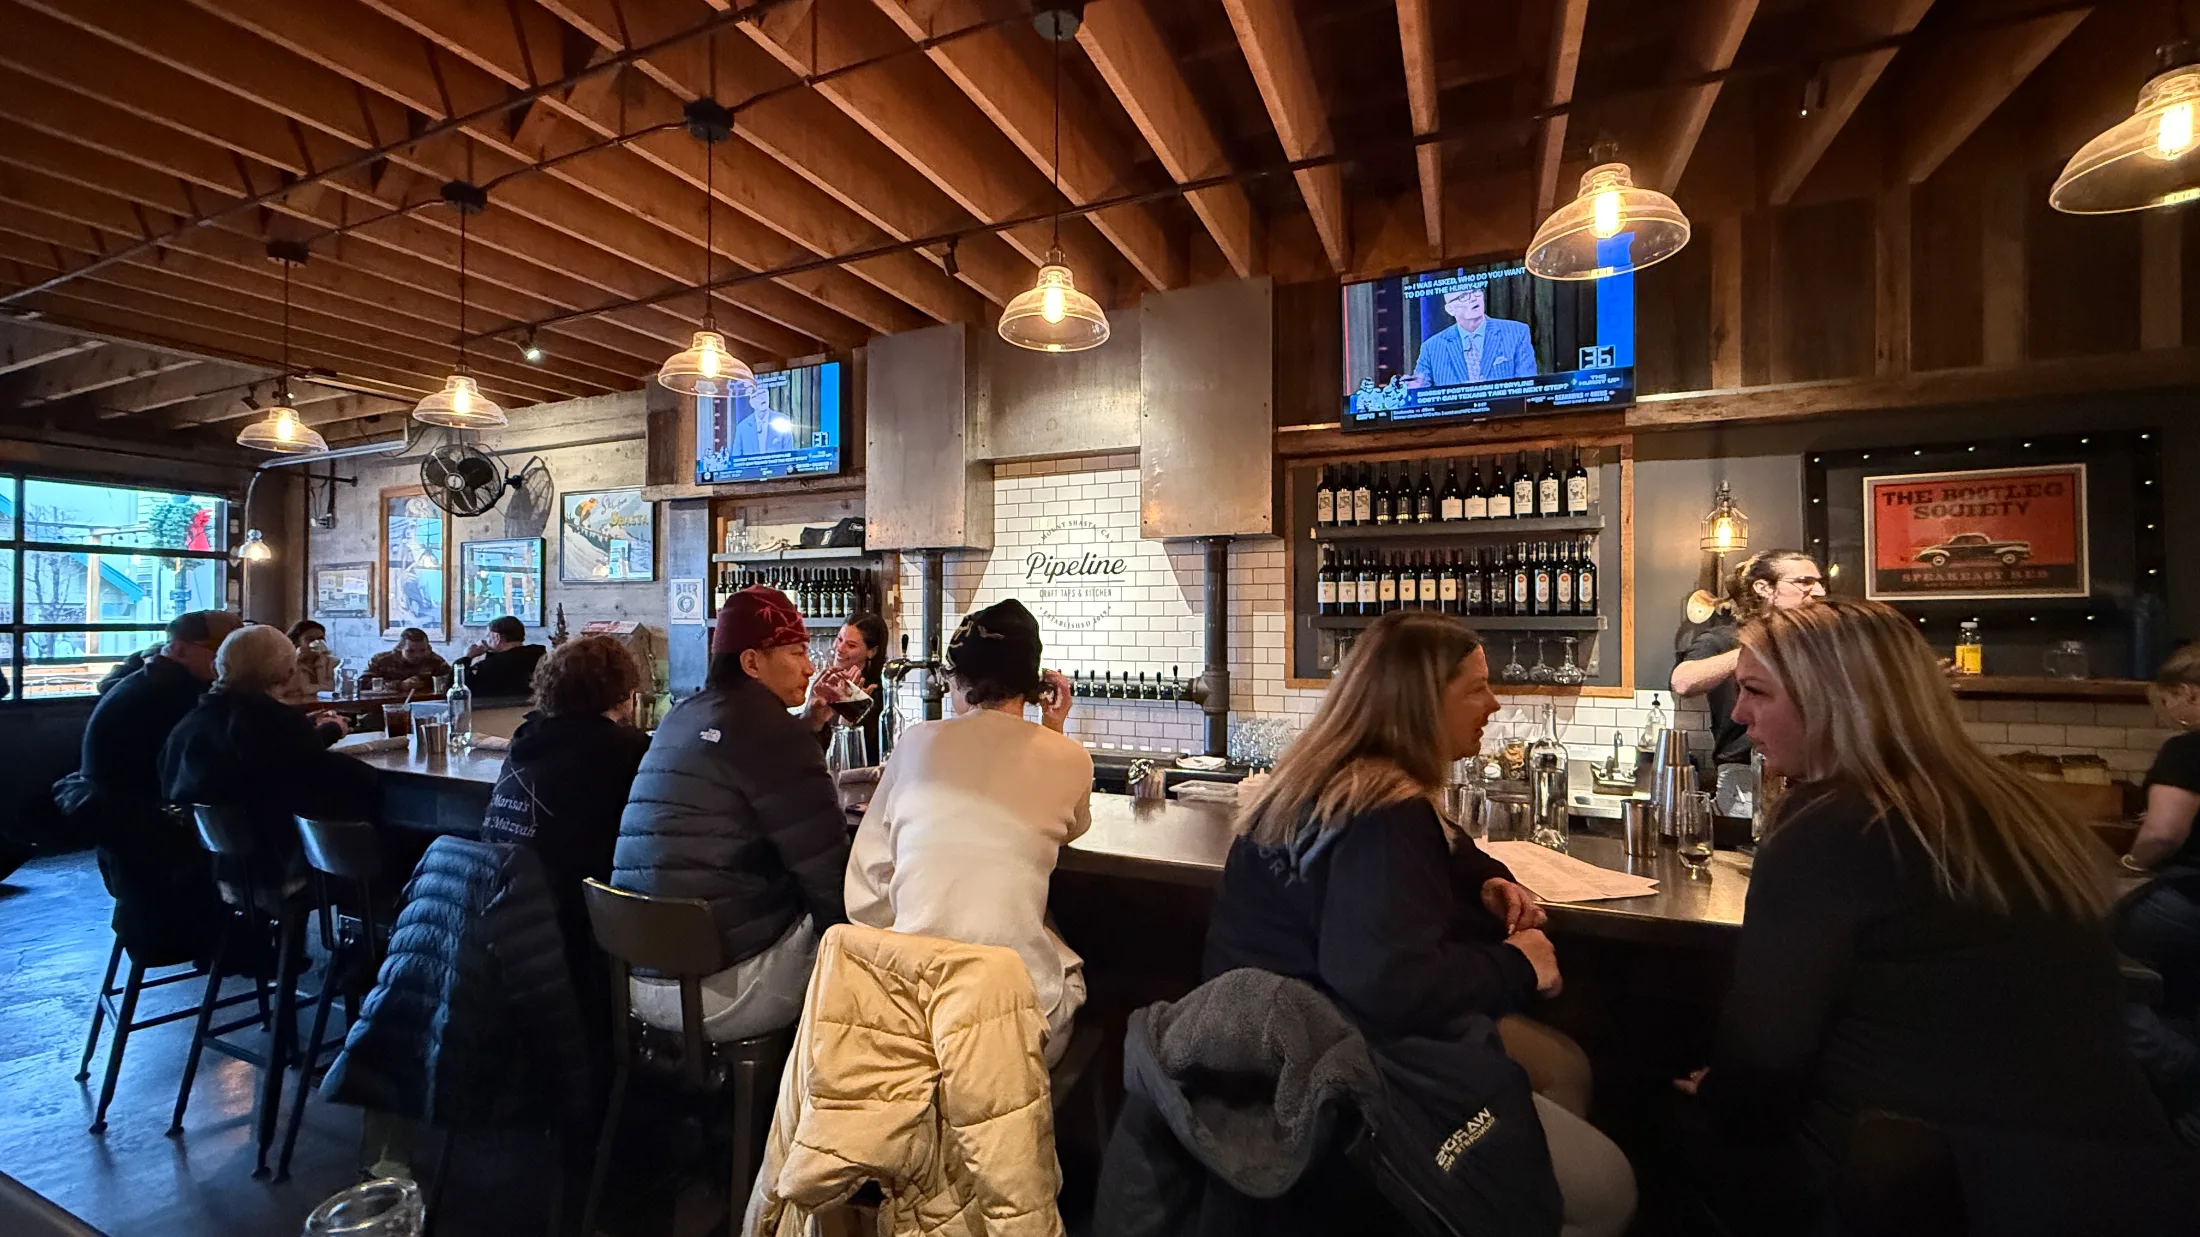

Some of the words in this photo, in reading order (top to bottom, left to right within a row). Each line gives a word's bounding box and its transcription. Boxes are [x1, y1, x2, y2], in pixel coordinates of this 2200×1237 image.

[1416, 280, 1433, 289] WAS
[1433, 277, 1457, 287] ASKED,
[1457, 274, 1475, 284] WHO
[1477, 272, 1487, 281] DO
[1488, 270, 1503, 279] YOU
[1504, 266, 1526, 277] WANT
[1404, 291, 1414, 299] TO
[1415, 289, 1425, 297] DO
[1426, 288, 1433, 296] IN
[1434, 286, 1448, 295] THE
[1449, 281, 1488, 292] HURRY-UP?
[1584, 346, 1611, 369] 36
[1446, 384, 1493, 394] POSTSEASON
[1494, 380, 1534, 389] STORYLINE
[1458, 391, 1487, 399] TEXANS
[1488, 389, 1507, 397] TAKE
[1523, 385, 1543, 393] NEXT
[1544, 383, 1569, 391] STEP?
[1579, 378, 1606, 386] HURRY
[1882, 489, 1933, 506] THE
[1943, 482, 2064, 501] BOOTLEG
[1914, 501, 2030, 519] SOCIETY
[1041, 521, 1066, 540] MOUNT
[1101, 529, 1110, 539] CA
[1026, 551, 1127, 583] Pipeline
[1902, 570, 2003, 583] SPEAKEASY
[676, 583, 698, 598] BEER
[1039, 589, 1058, 598] CRAFT
[1061, 589, 1075, 597] TAPS
[1078, 589, 1082, 597] &
[1085, 589, 1111, 597] KITCHEN
[1043, 610, 1091, 629] ESTABLISHED
